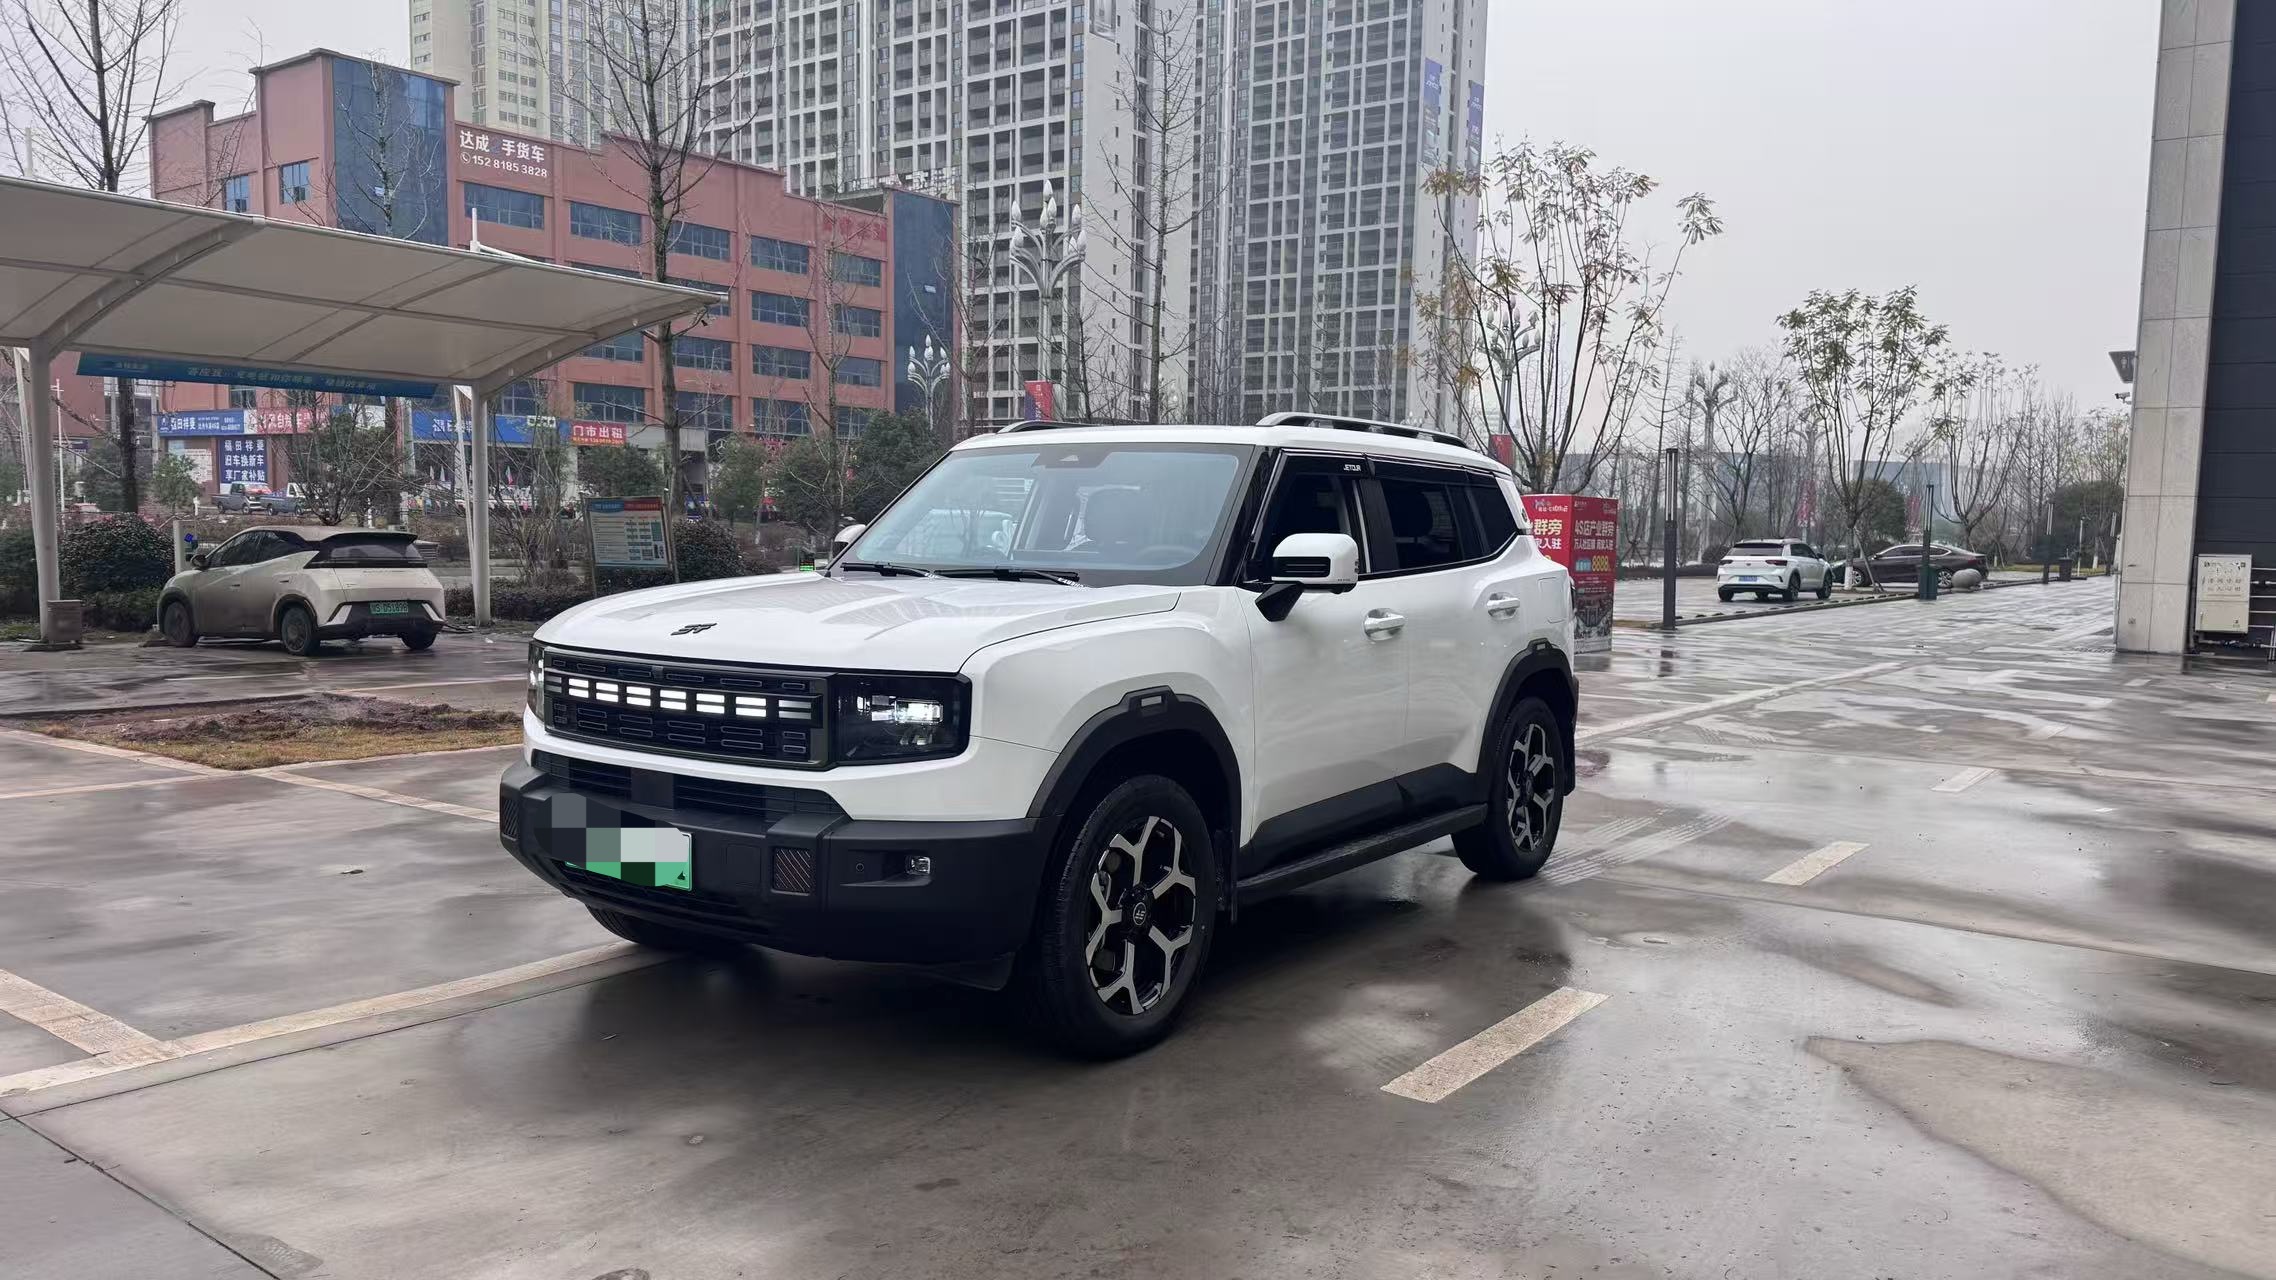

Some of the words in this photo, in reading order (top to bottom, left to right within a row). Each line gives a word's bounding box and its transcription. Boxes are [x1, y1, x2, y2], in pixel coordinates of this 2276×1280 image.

[460, 130, 544, 163] 达成手货车
[472, 155, 491, 167] 152
[493, 159, 519, 172] 8185
[521, 165, 547, 177] 3828
[573, 425, 623, 439] 门市出租
[224, 455, 264, 467] 旧车换新车
[225, 470, 265, 481] 享厂家补贴
[1534, 519, 1562, 535] 群旁
